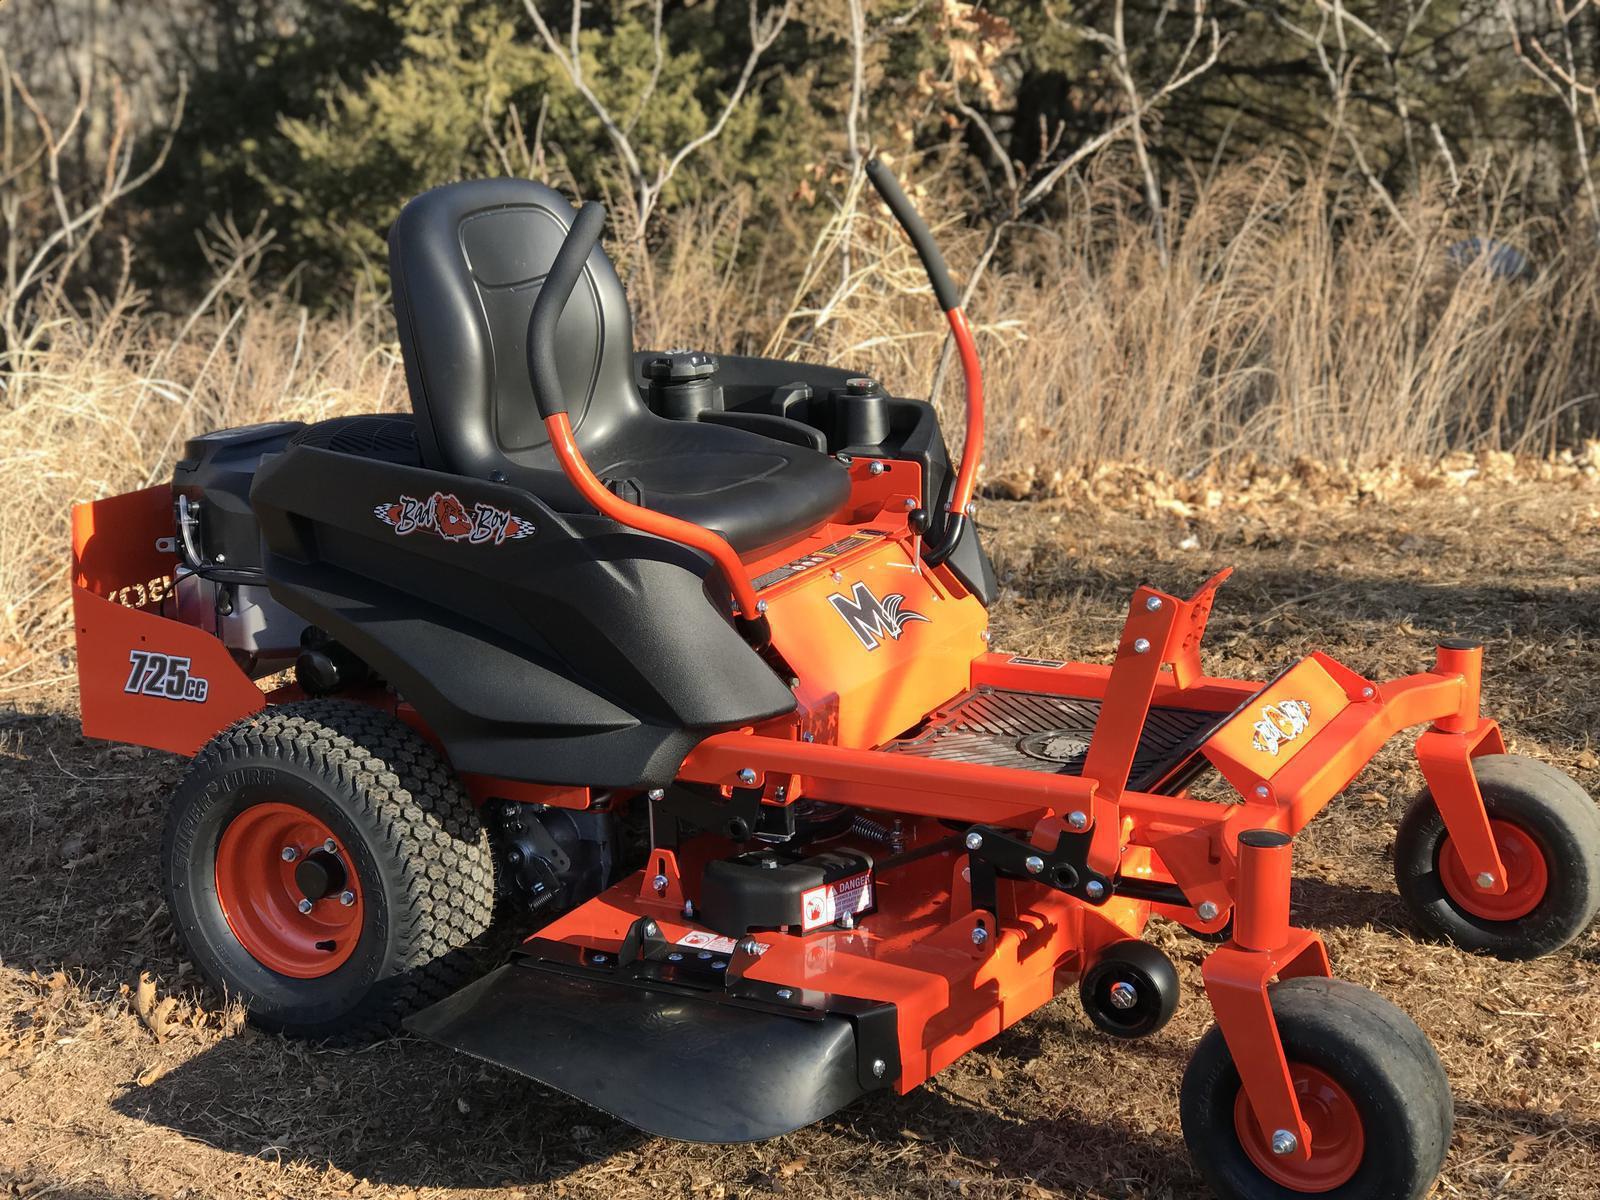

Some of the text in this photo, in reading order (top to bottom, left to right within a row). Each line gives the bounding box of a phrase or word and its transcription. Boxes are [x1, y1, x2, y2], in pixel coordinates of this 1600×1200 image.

[396, 495, 511, 544] Bad Boy
[124, 650, 209, 702] 725cc
[839, 874, 871, 893] DANGER
